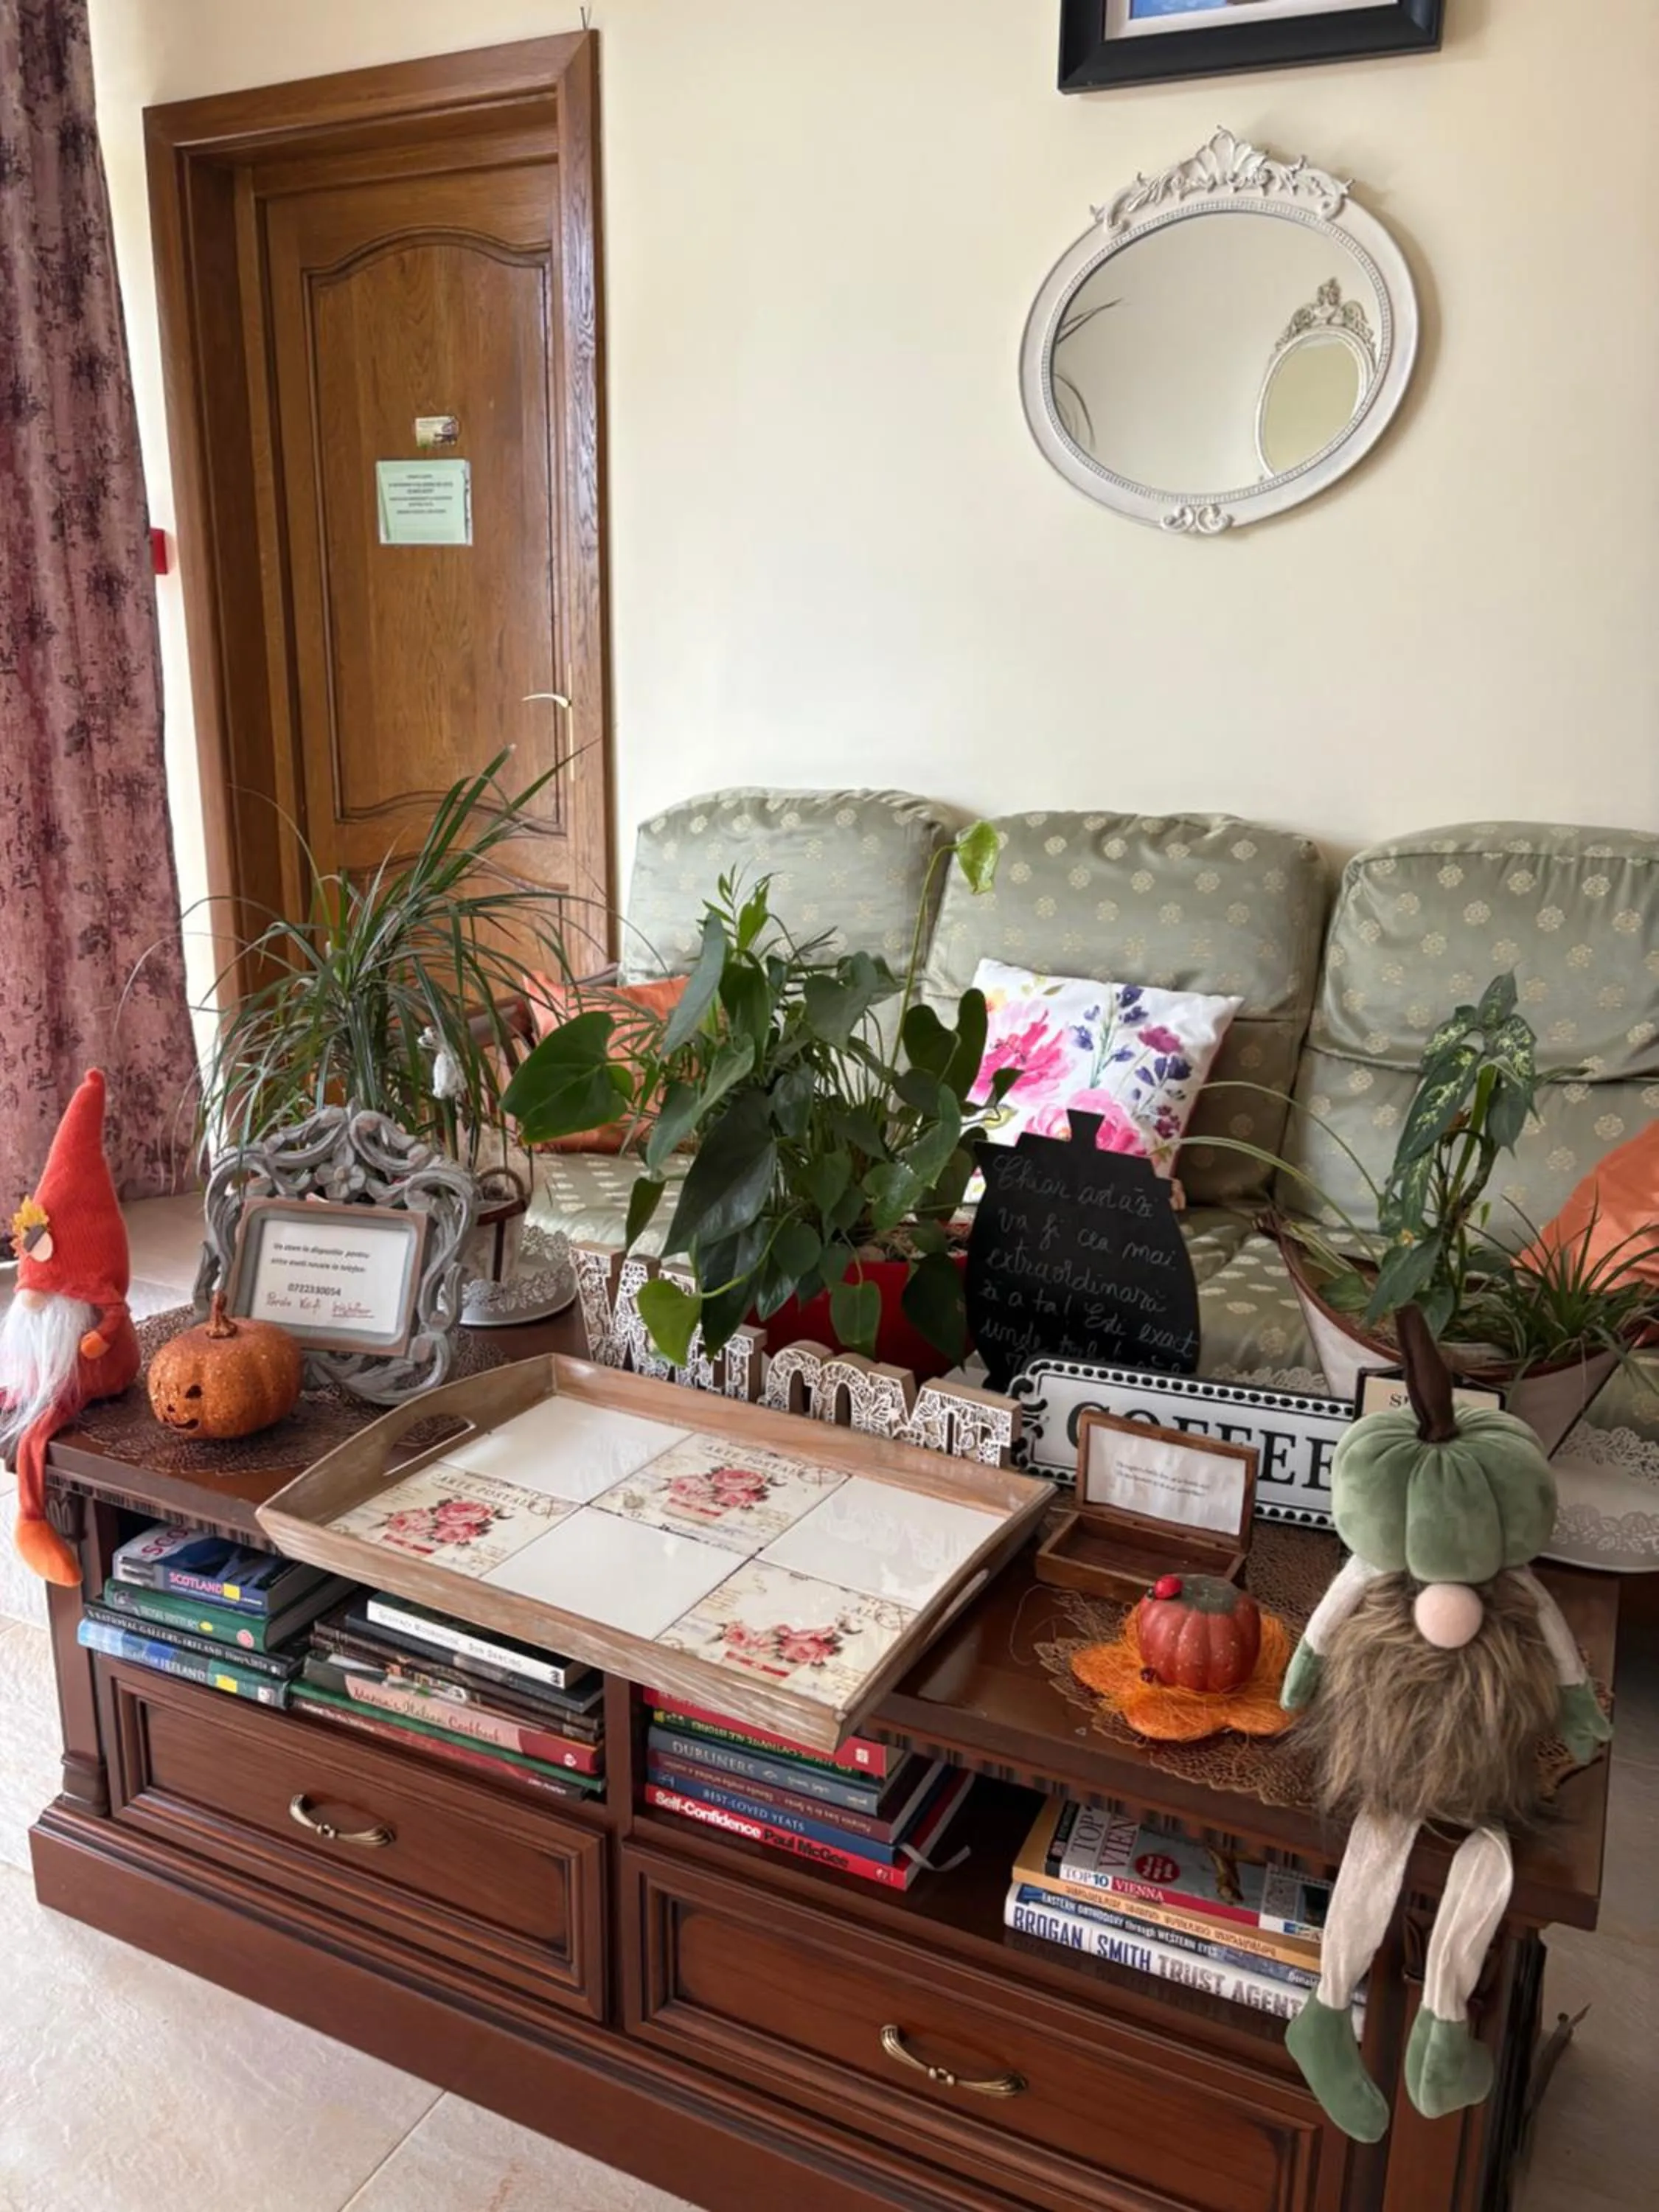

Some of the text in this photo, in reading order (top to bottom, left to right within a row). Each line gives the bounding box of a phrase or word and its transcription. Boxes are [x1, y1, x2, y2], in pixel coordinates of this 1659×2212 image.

[1122, 1242, 1176, 1267] mai
[168, 1571, 223, 1595] SCOTLAND
[672, 1740, 755, 1775] DUBLINERS
[655, 1790, 761, 1839] Self-Confidence
[771, 1812, 805, 1832] YEATS
[1114, 1879, 1164, 1902] VIENNA
[1157, 1927, 1197, 1950] WESTERN
[1014, 1904, 1084, 1950] BROGAN
[1096, 1935, 1151, 1972] SMITH
[1158, 1953, 1226, 1998] TRUST
